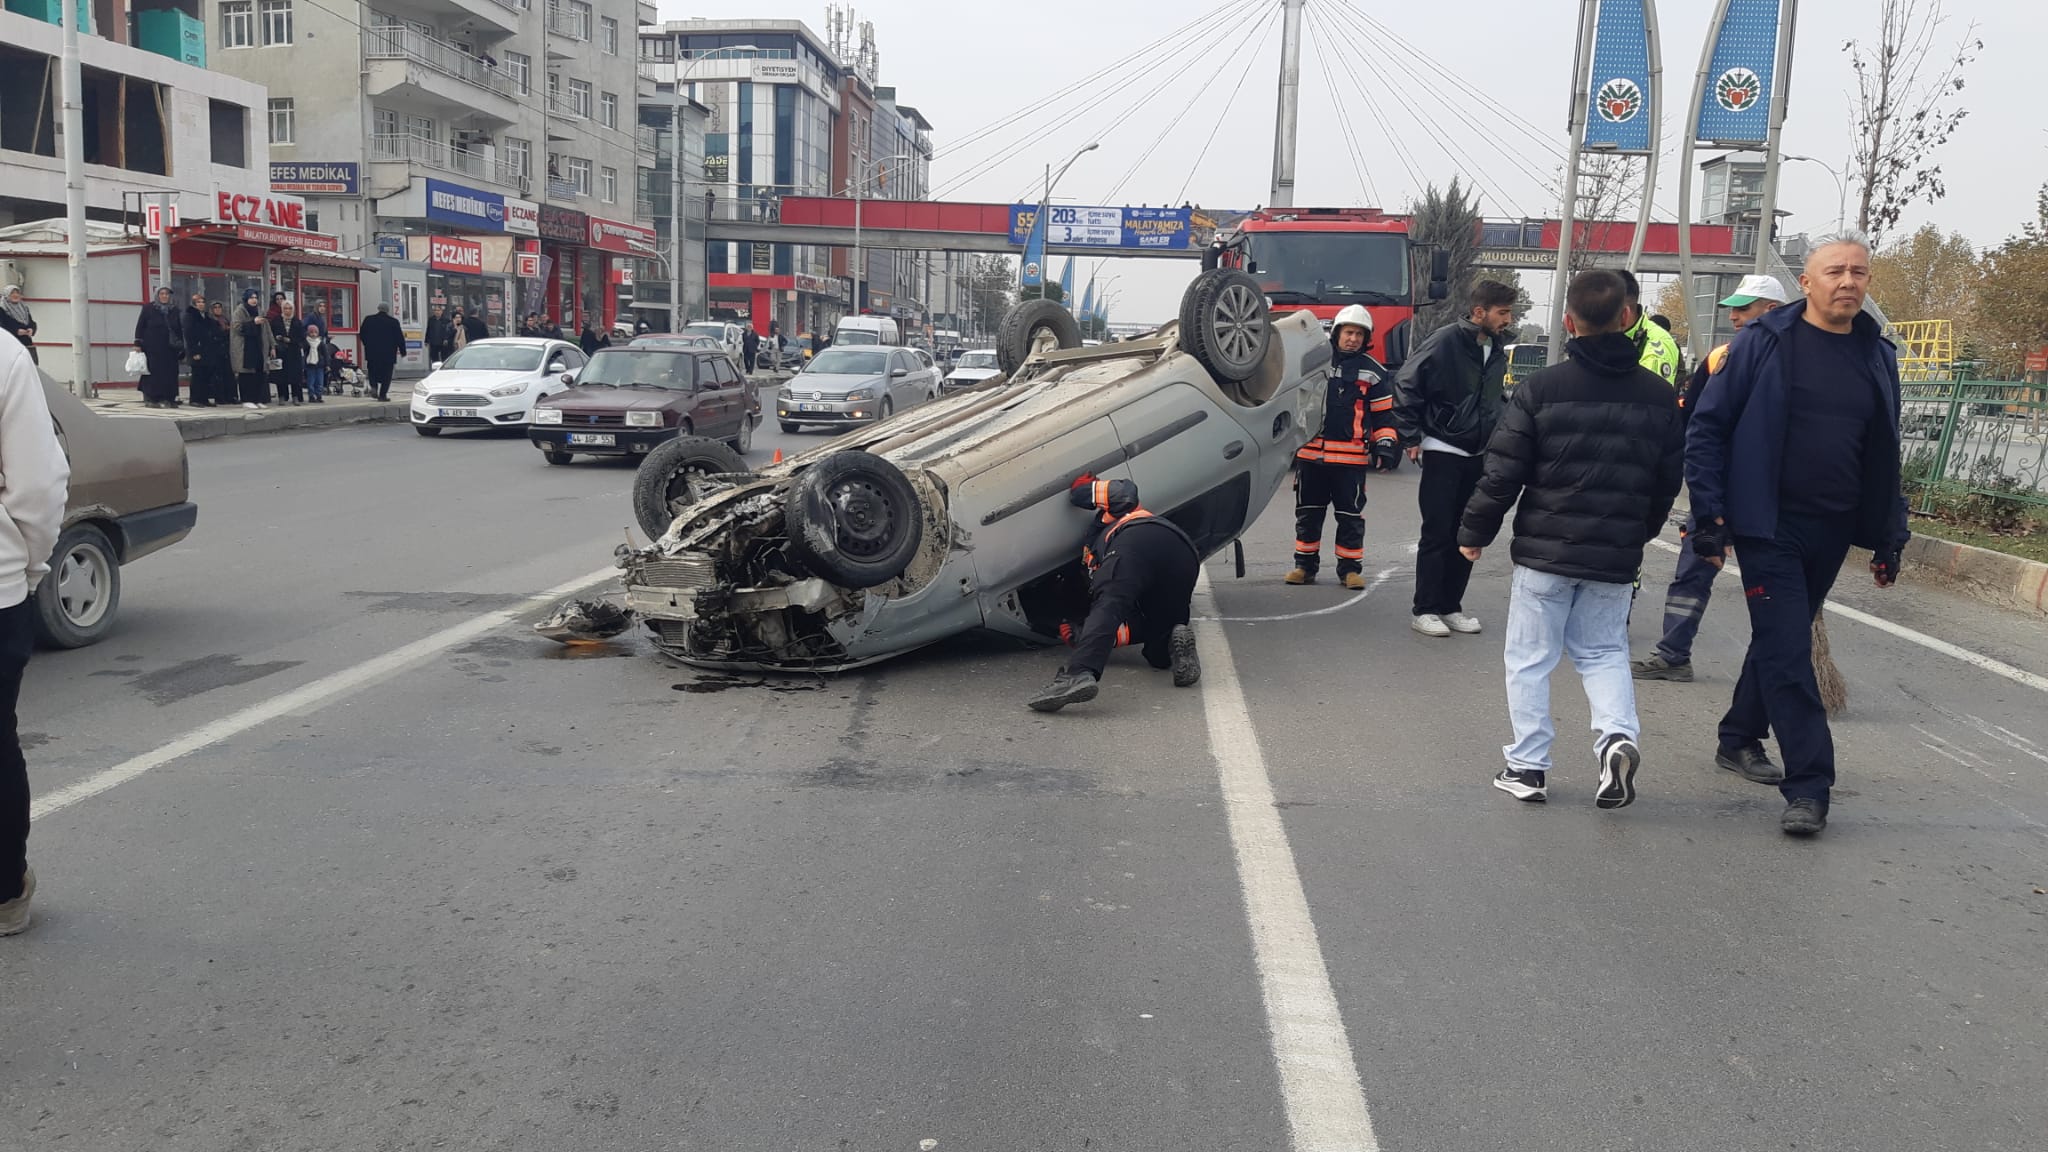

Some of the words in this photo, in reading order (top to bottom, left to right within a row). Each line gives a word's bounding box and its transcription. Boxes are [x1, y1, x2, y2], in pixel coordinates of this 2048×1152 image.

[298, 163, 351, 180] MEDİKAL
[512, 206, 537, 221] ECZANE
[1051, 208, 1077, 224] 203
[1125, 219, 1184, 231] MALATYAMIZA
[243, 229, 269, 240] MALATYA
[1063, 226, 1073, 242] 3
[432, 242, 480, 267] ECZANE
[522, 259, 534, 273] E
[573, 434, 581, 443] 44
